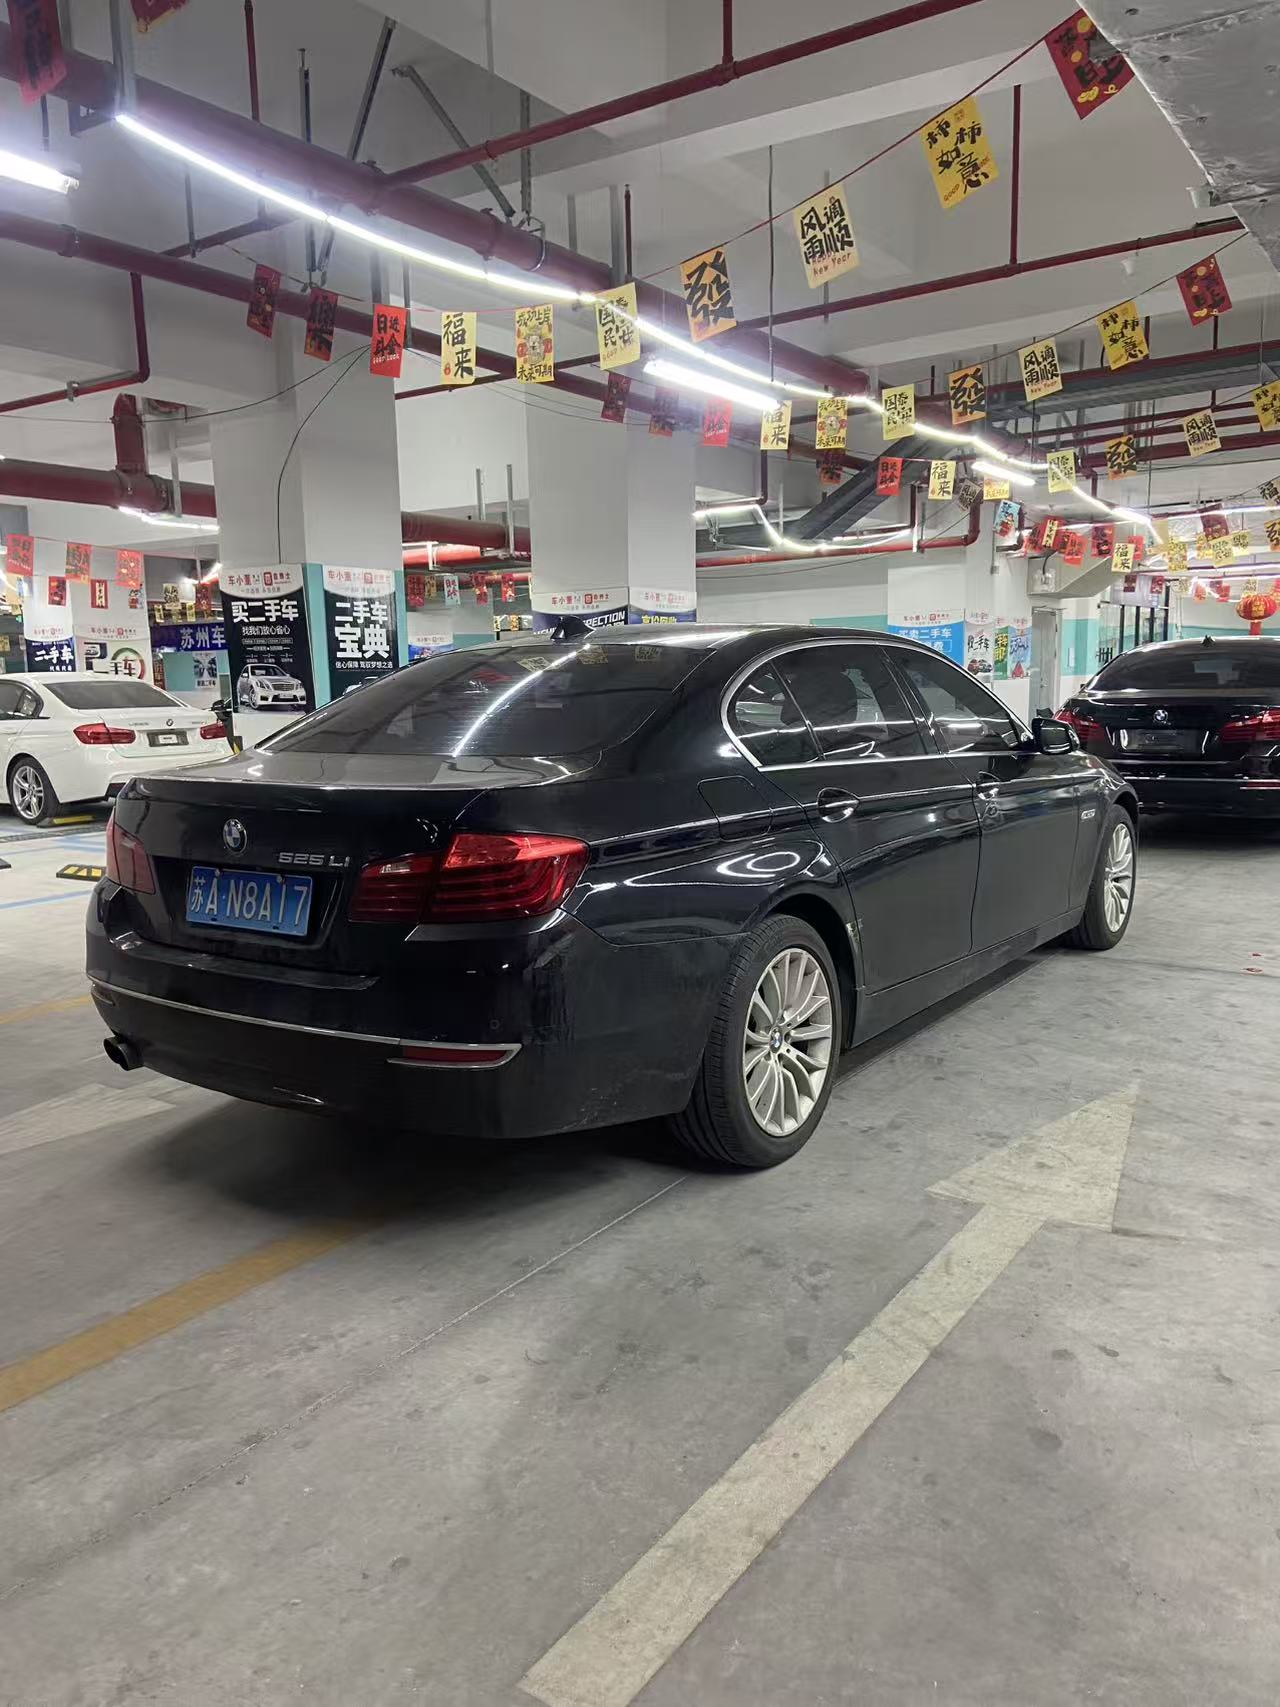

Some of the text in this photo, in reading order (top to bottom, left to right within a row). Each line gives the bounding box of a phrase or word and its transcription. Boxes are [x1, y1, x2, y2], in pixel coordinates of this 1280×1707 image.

[936, 146, 990, 195] 如意
[443, 312, 475, 380] 福来
[932, 461, 952, 497] 福来
[231, 599, 300, 623] 买二手车
[335, 601, 389, 625] 二手车
[583, 610, 626, 628] PECTION
[180, 625, 226, 650] 苏州车
[335, 623, 390, 659] 宝典
[34, 644, 75, 665] 二手车
